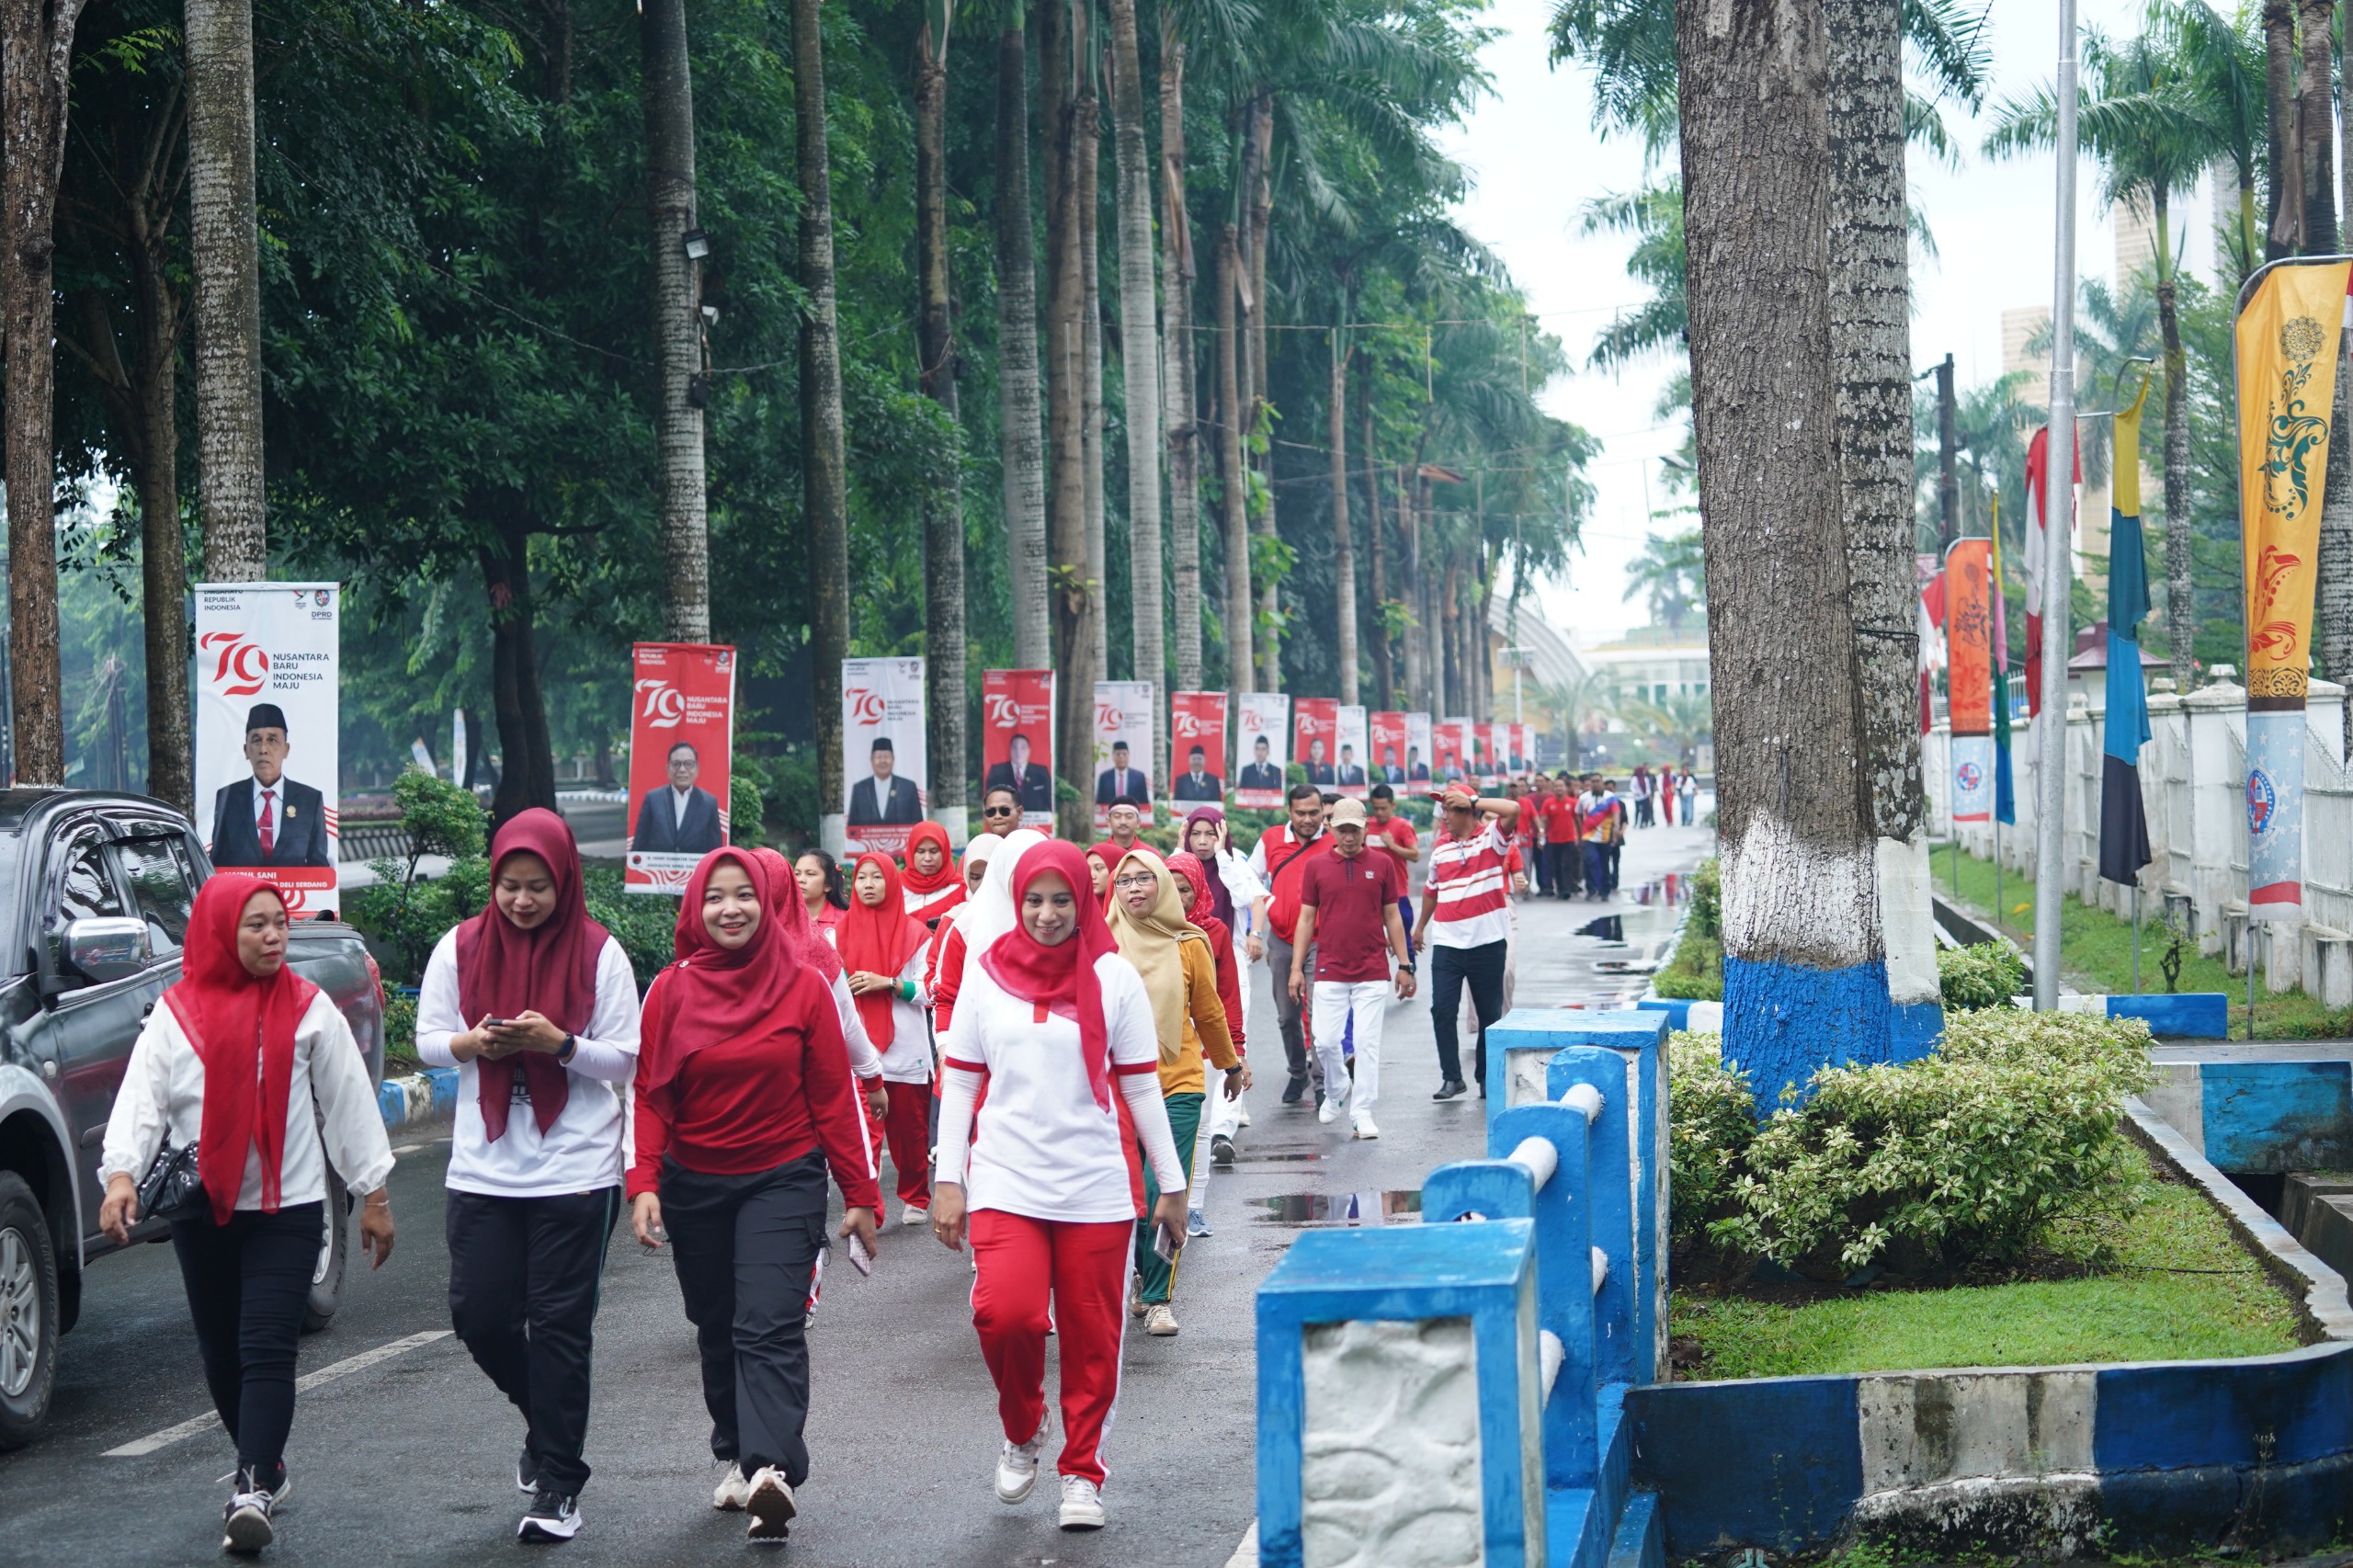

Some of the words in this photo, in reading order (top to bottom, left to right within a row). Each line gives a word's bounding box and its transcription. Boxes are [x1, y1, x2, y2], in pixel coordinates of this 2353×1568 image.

[199, 631, 269, 697] 79
[273, 662, 299, 670] BARU
[273, 673, 324, 681] INDONESIA
[634, 678, 685, 728] 79
[687, 696, 728, 704] NUSANTARA
[845, 687, 885, 726] 79
[984, 693, 1020, 728] 79
[1172, 710, 1200, 738] 79
